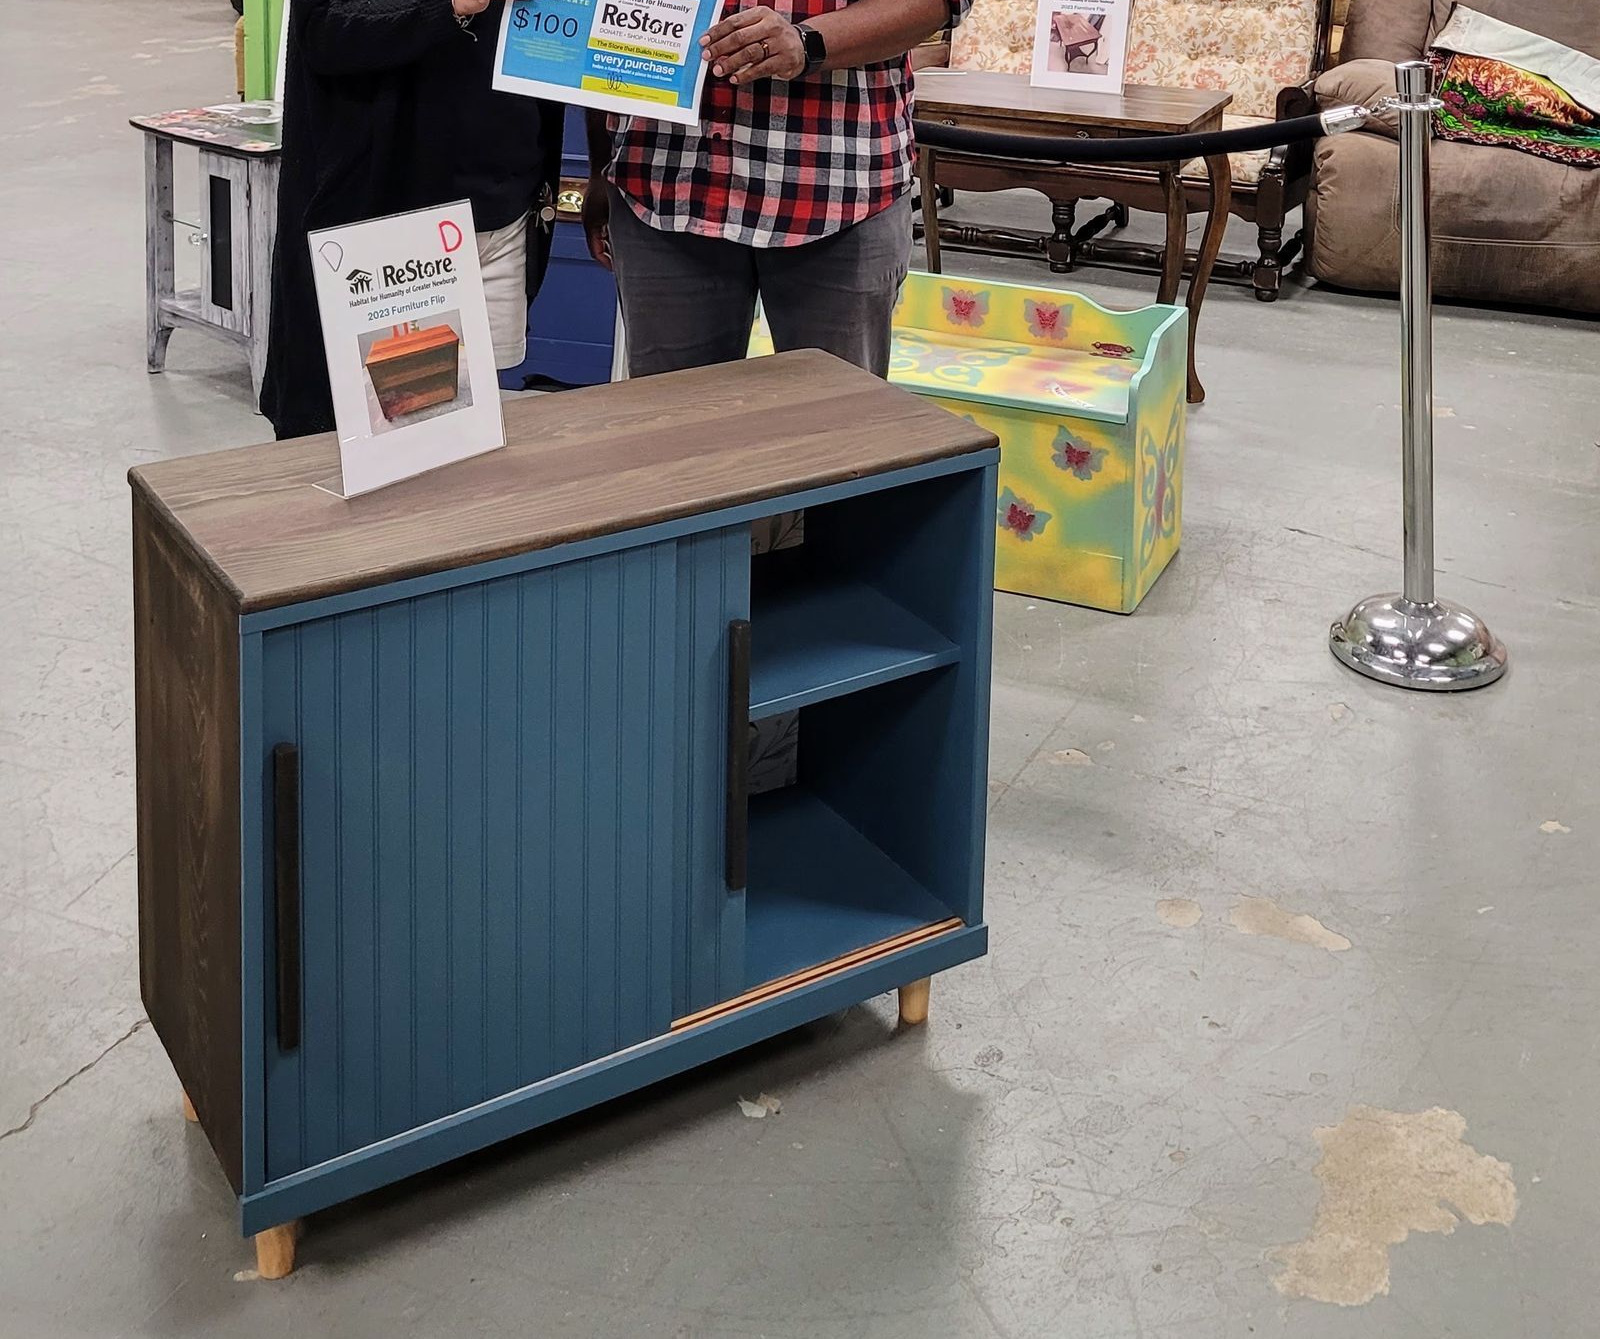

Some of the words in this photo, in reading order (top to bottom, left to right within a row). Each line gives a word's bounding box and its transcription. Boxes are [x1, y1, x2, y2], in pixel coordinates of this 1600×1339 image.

[513, 6, 579, 38] $100
[601, 3, 684, 39] ReStore
[657, 1, 691, 14] Humanity
[599, 27, 622, 37] DONATE
[647, 37, 681, 48] VOLUNTEER
[593, 53, 624, 68] every
[624, 59, 675, 76] purchase
[438, 219, 463, 253] D
[382, 257, 453, 288] ReStore
[349, 297, 369, 308] Habitat
[370, 295, 378, 303] for
[379, 289, 404, 301] Humanity
[405, 286, 411, 294] of
[412, 283, 431, 293] Greater
[432, 275, 457, 288] Newburgh
[367, 308, 390, 321] 2023
[391, 299, 429, 316] Furniture
[430, 294, 446, 306] Flip
